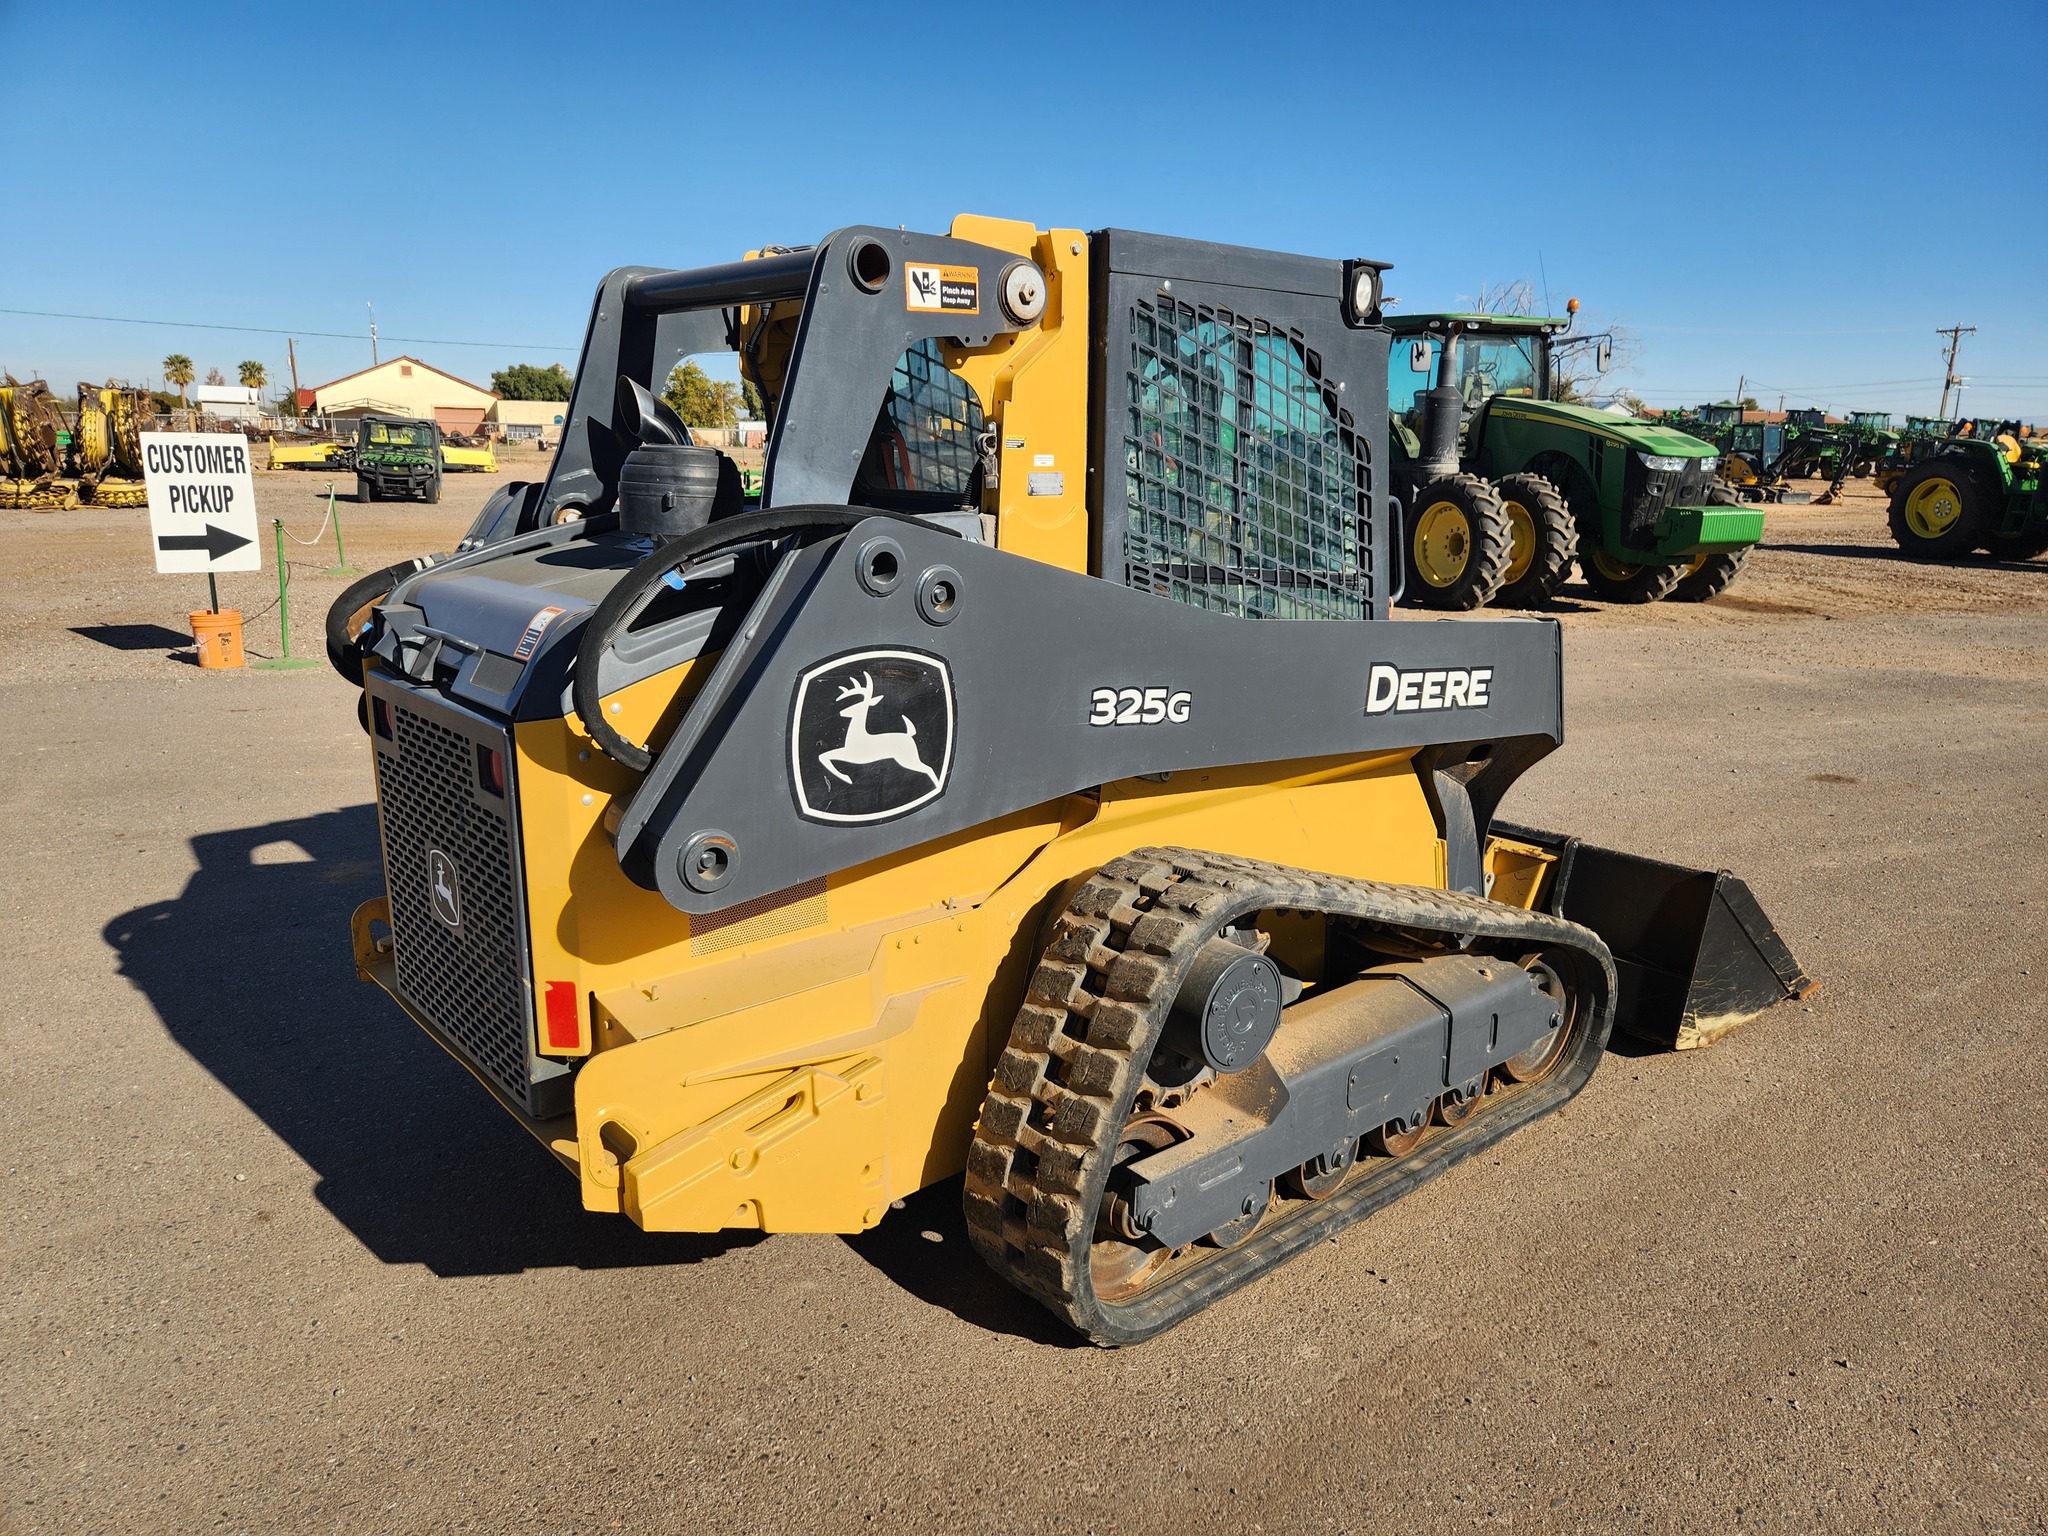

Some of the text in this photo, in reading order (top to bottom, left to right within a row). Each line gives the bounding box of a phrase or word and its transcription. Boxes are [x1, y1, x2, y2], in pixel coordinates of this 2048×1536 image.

[942, 286, 975, 296] Pinch Area
[942, 296, 971, 306] Keep Away
[147, 444, 246, 474] CUSTOMER
[169, 484, 234, 513] PICKUP
[1366, 665, 1492, 712] DEERE
[1090, 688, 1192, 725] 325G
